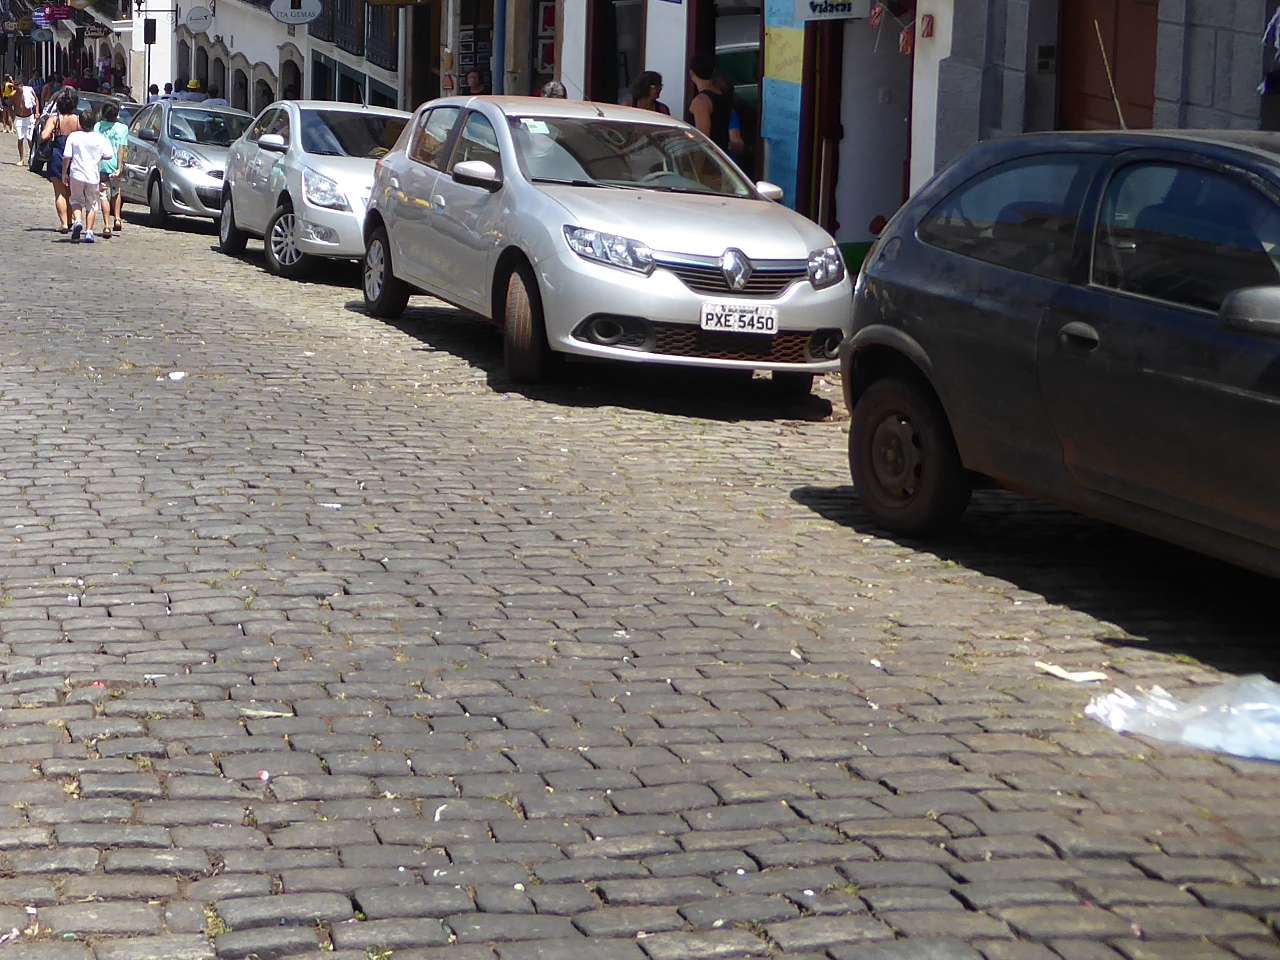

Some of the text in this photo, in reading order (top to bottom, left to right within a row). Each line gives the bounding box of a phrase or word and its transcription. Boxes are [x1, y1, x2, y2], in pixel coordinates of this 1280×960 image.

[290, 10, 316, 18] GEMAS
[705, 312, 774, 330] PXE 5450
